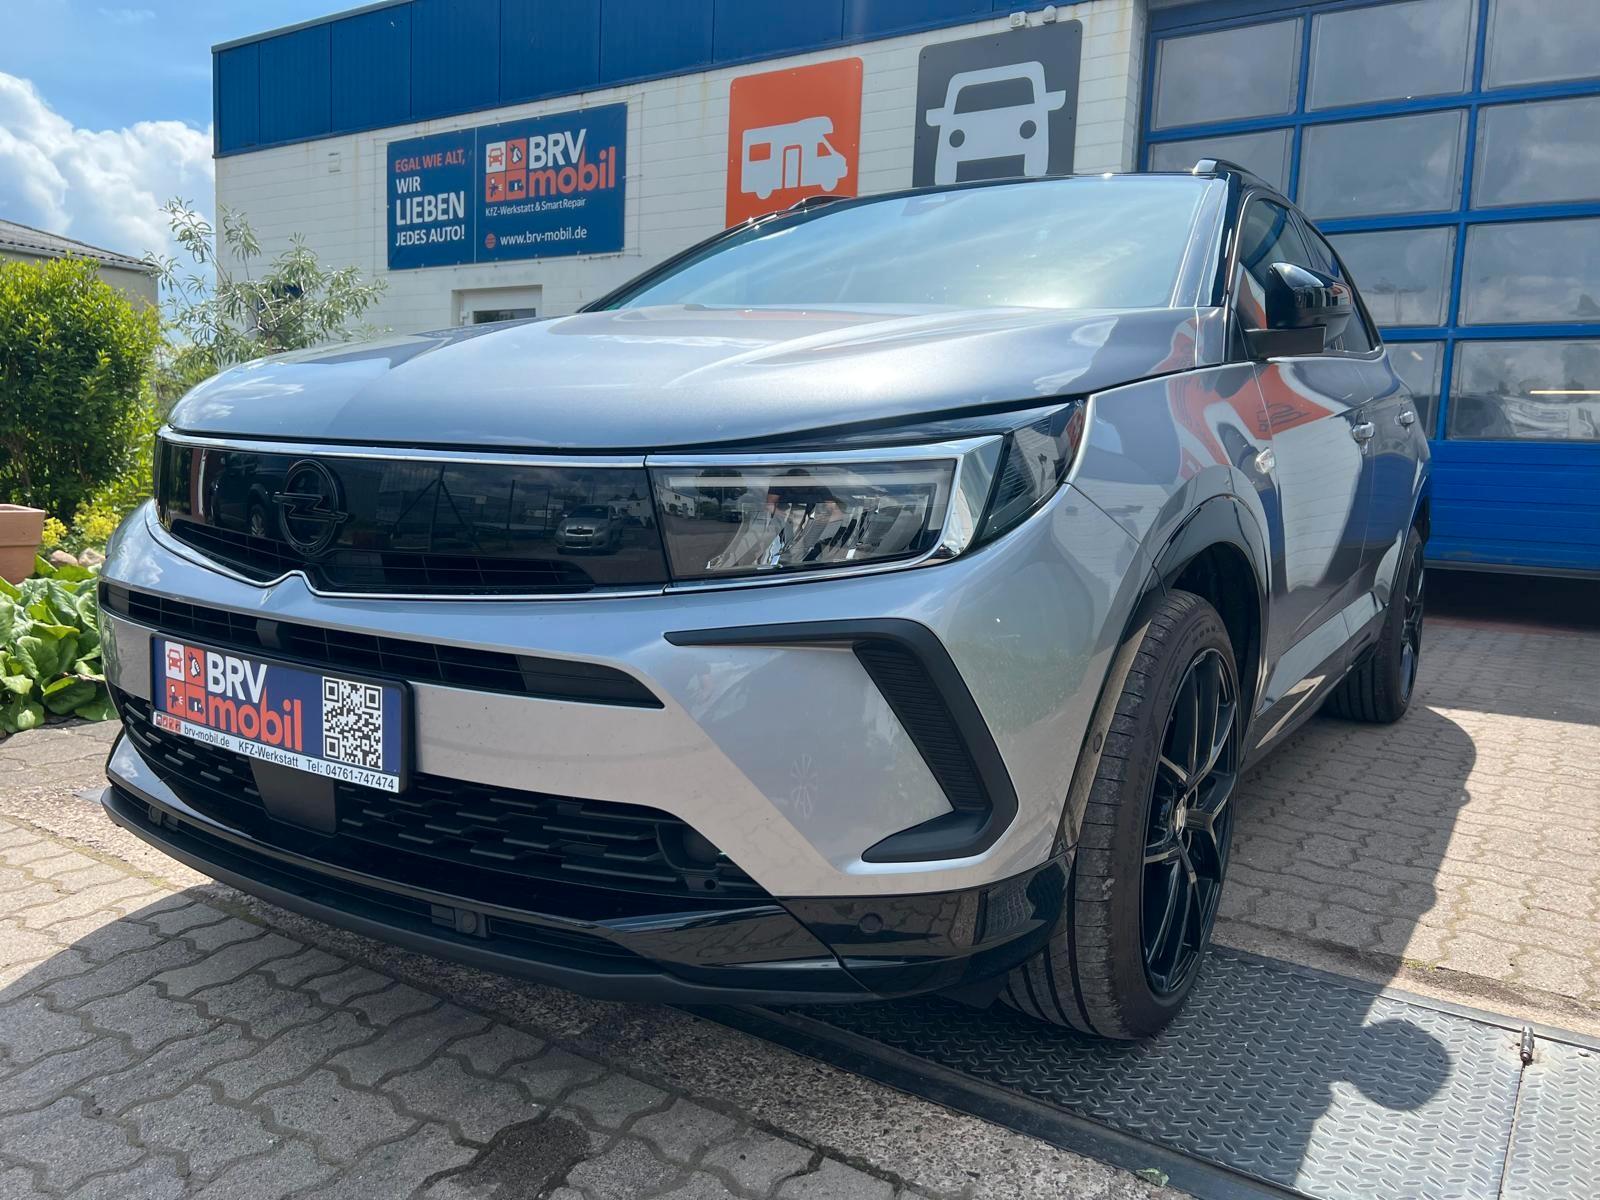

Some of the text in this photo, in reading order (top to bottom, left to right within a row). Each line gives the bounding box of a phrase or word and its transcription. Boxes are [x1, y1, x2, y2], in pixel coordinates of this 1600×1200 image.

[395, 149, 465, 173] EGAL WIE ALT,
[528, 128, 587, 169] BRV
[396, 176, 421, 194] WIR
[528, 146, 616, 198] mobil
[396, 190, 465, 226] LIEBEN
[563, 197, 587, 209] Repair
[395, 224, 465, 247] JEDES AUTO!
[500, 225, 588, 246] www.brv-mobil.de
[206, 651, 268, 704] BRV
[207, 688, 303, 752] mobil
[184, 724, 395, 790] brv-mobil.de KFZ-Werkstatt Tel: 04761-747474
